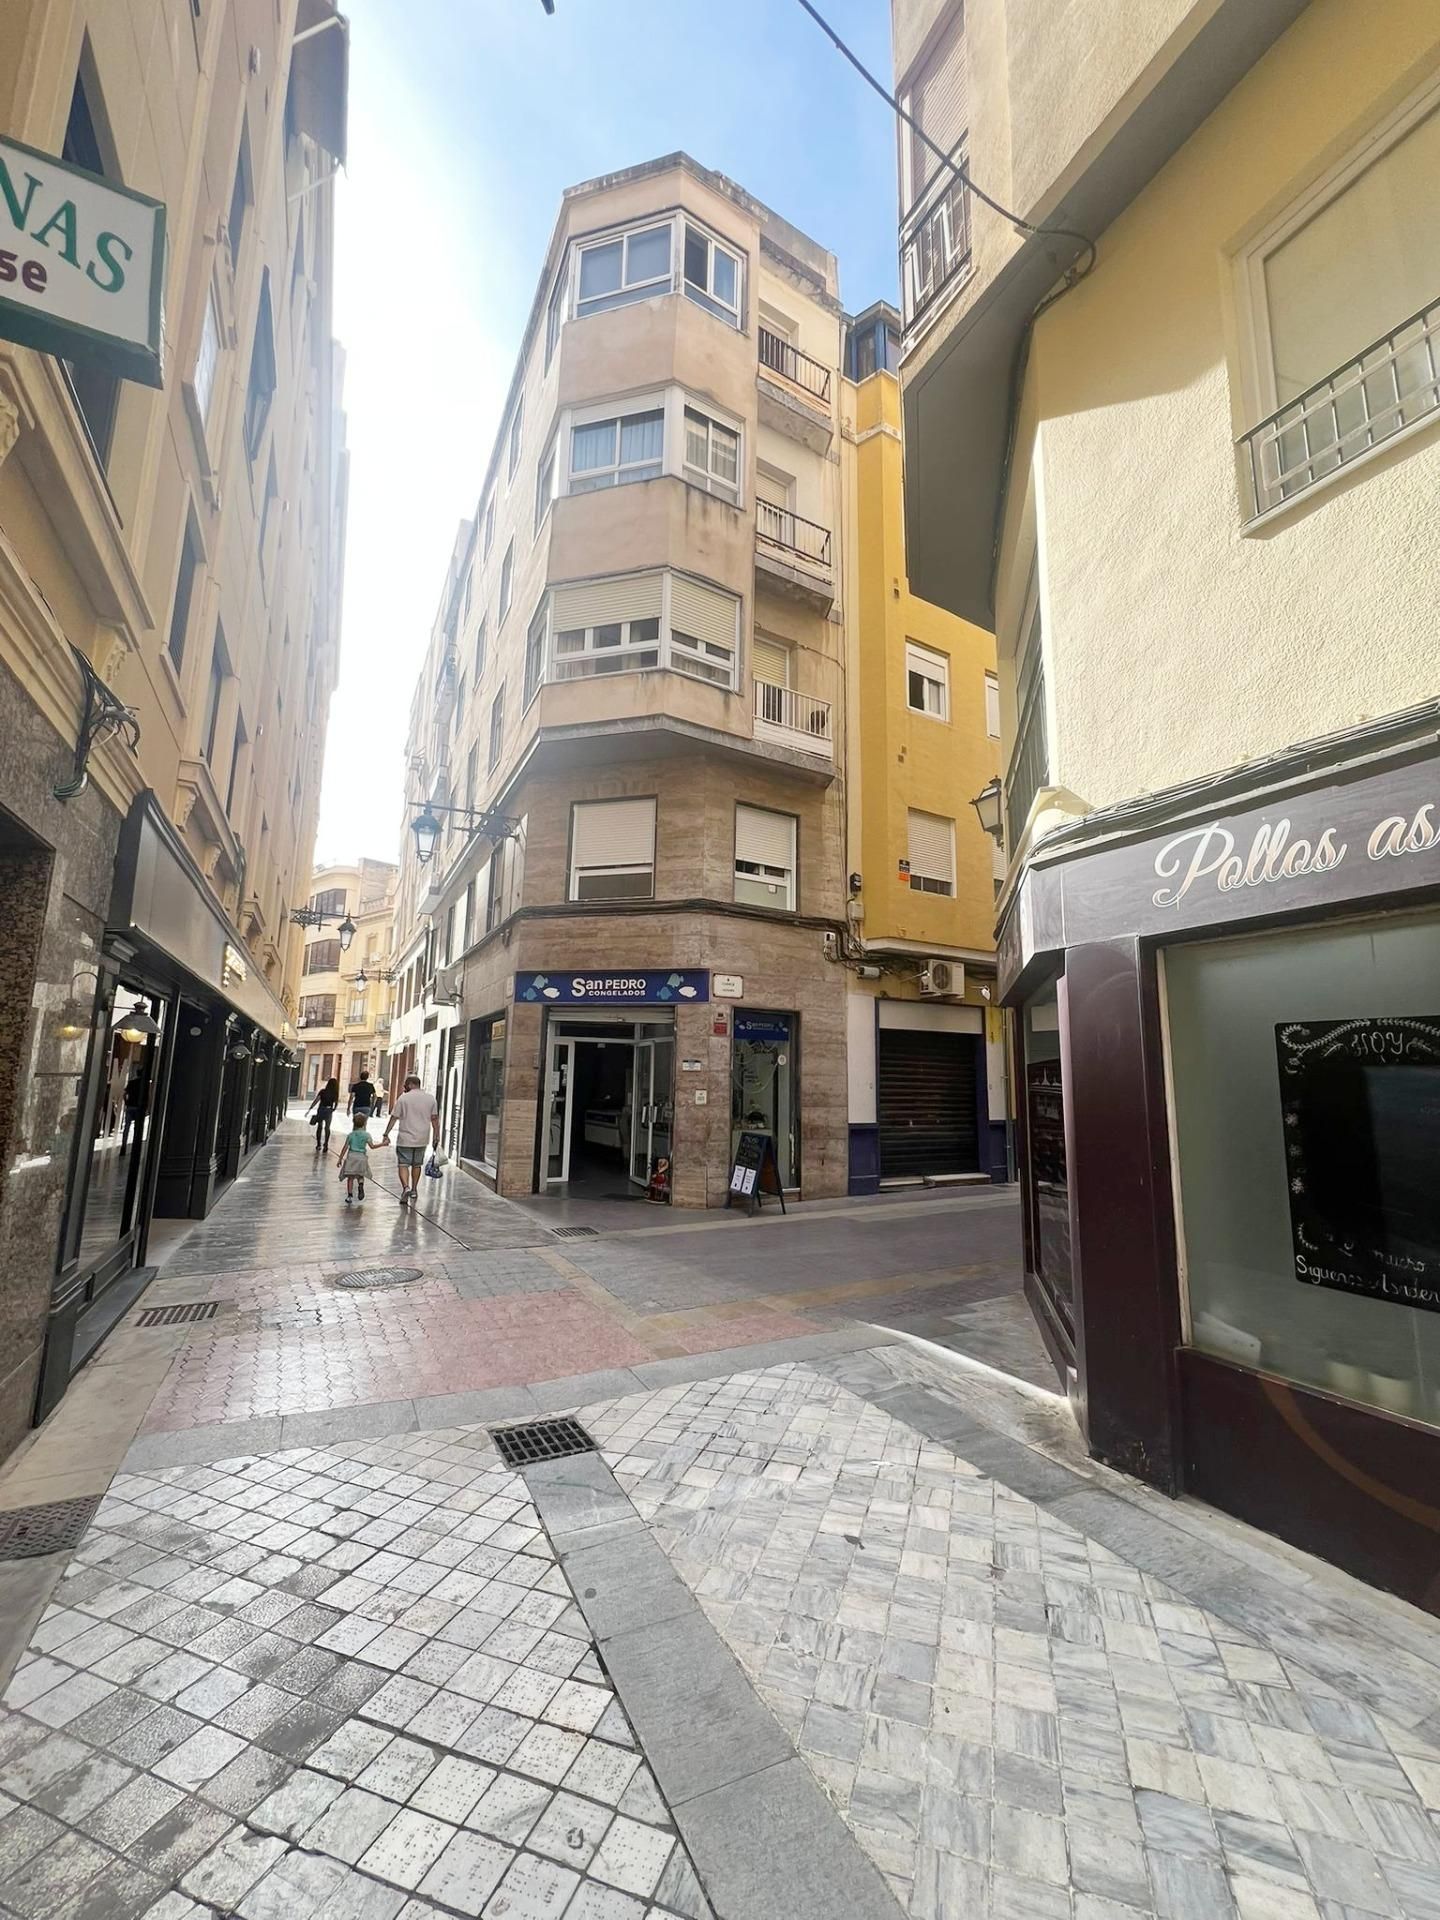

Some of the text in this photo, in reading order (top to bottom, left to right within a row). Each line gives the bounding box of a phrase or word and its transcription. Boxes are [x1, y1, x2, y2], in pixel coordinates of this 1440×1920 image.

[1152, 817, 1348, 910] Pollos
[571, 977, 647, 997] San PEDRO
